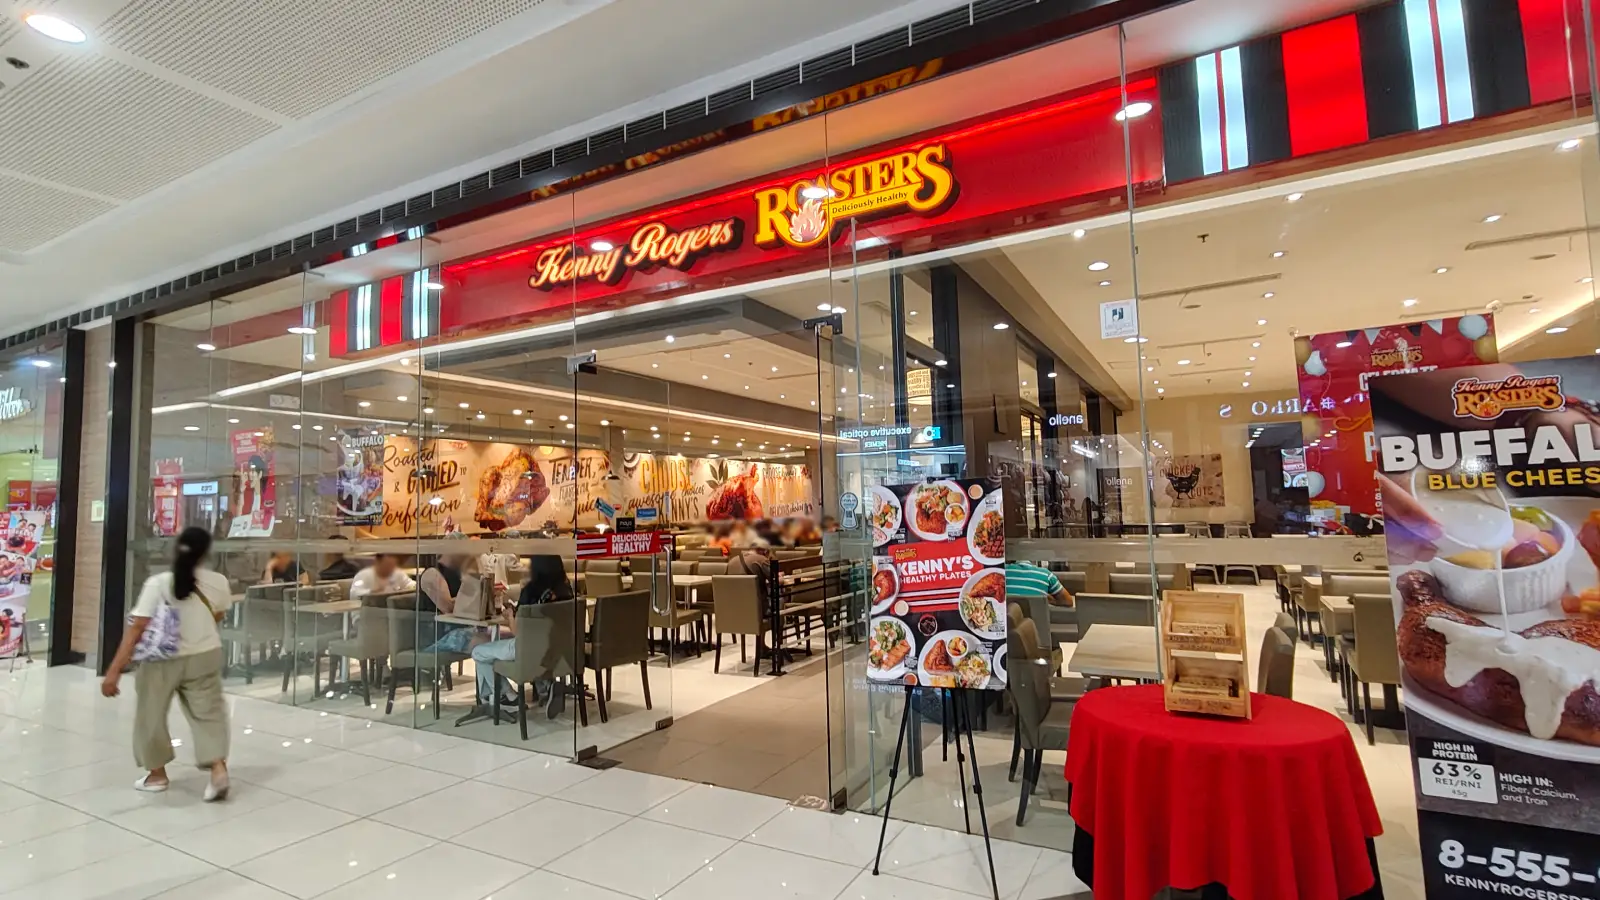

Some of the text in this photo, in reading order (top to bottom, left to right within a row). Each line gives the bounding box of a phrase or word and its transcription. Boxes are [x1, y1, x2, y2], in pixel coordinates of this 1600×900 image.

[754, 143, 951, 246] ROASTERS
[832, 191, 909, 214] Deliciously Healthy
[529, 217, 735, 288] Kenny Rogers
[1454, 375, 1558, 393] Kenny Rogers
[1455, 385, 1563, 416] ROASTERS
[351, 435, 384, 448] BUFFALO
[640, 458, 693, 494] CHOOSE
[1428, 471, 1497, 491] BLUE
[611, 533, 653, 543] DELICIOUSLY
[611, 541, 651, 555] HEALTHY
[896, 555, 974, 576] KENNY'S
[901, 570, 972, 585] HEALTHY PLATES
[1432, 749, 1478, 762] PROTEIN
[1433, 741, 1475, 753] HIGH IN
[1432, 762, 1482, 781] 63%
[1499, 773, 1554, 788] HIGH IN:
[1500, 783, 1580, 801] Fiber, Calcium,
[1502, 794, 1549, 806] and Iron
[1438, 839, 1600, 887] 8-555-
